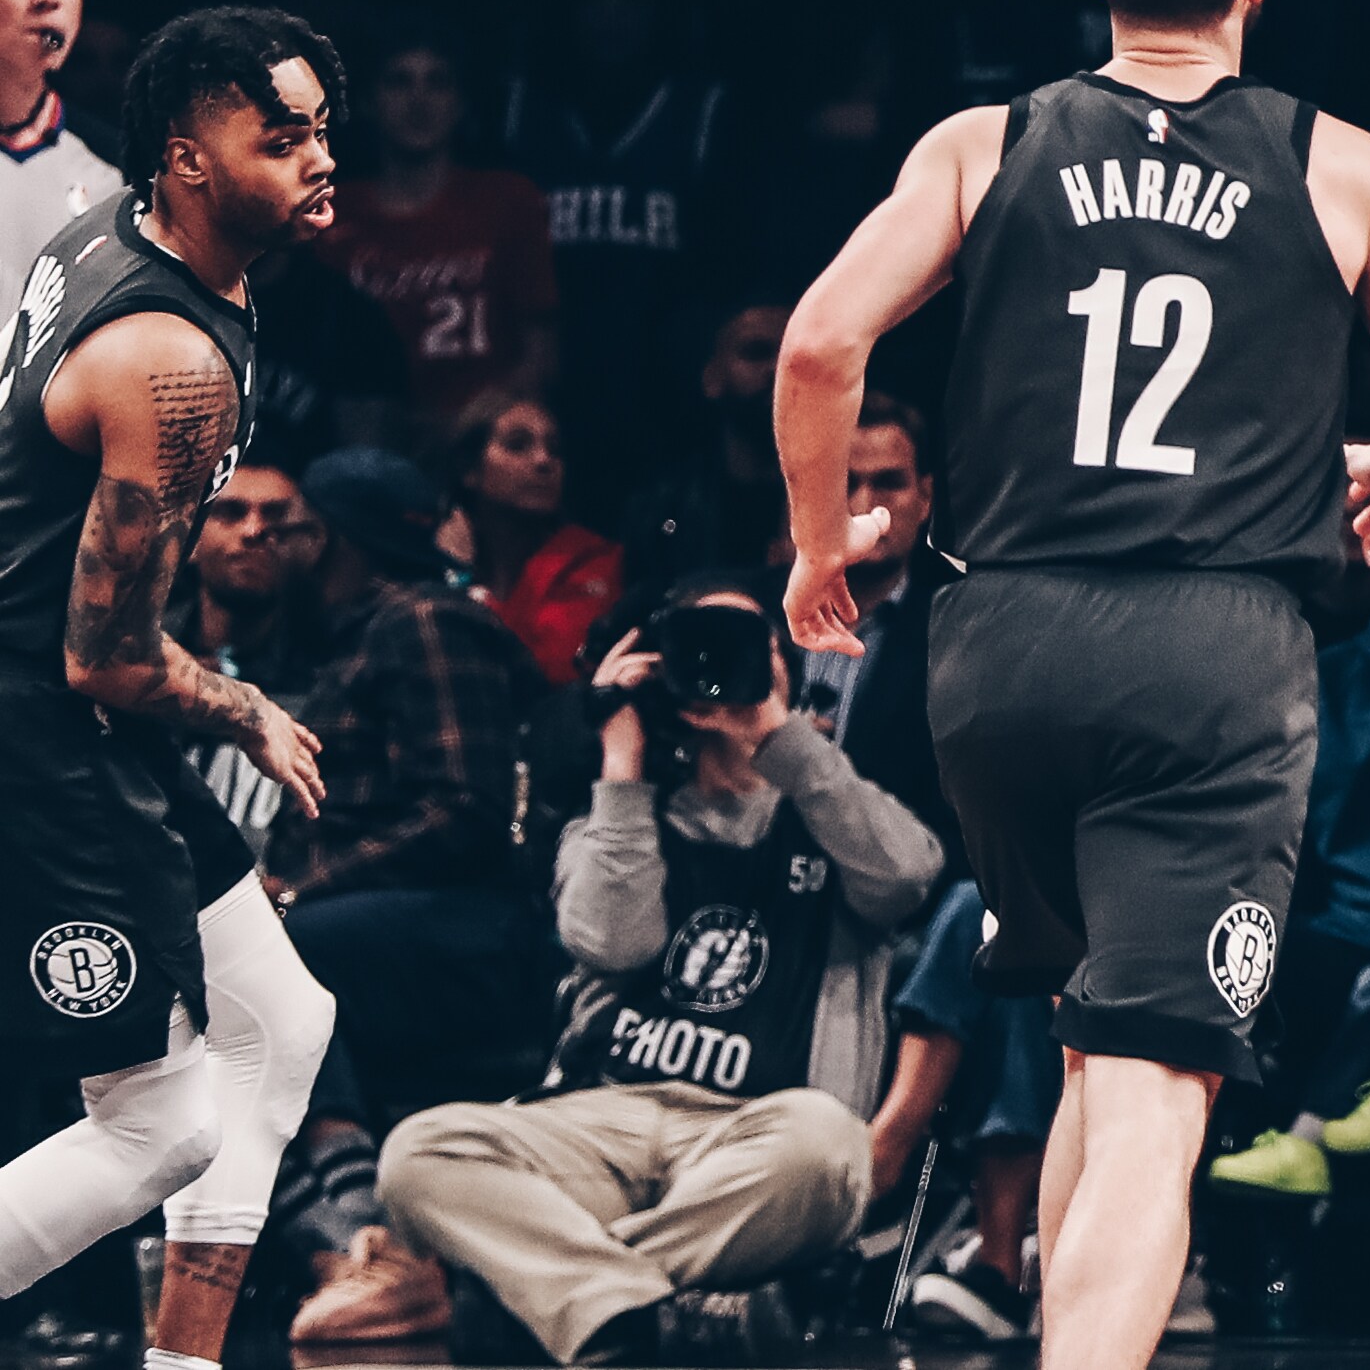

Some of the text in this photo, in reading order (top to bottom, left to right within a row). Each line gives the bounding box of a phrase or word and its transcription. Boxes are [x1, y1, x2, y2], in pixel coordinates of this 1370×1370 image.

[1058, 157, 1251, 241] HARRIS
[420, 291, 493, 359] 21
[1067, 266, 1214, 476] 12
[36, 926, 123, 961] BROOKLYN
[68, 947, 96, 993] B
[609, 1006, 753, 1092] PHOTO
